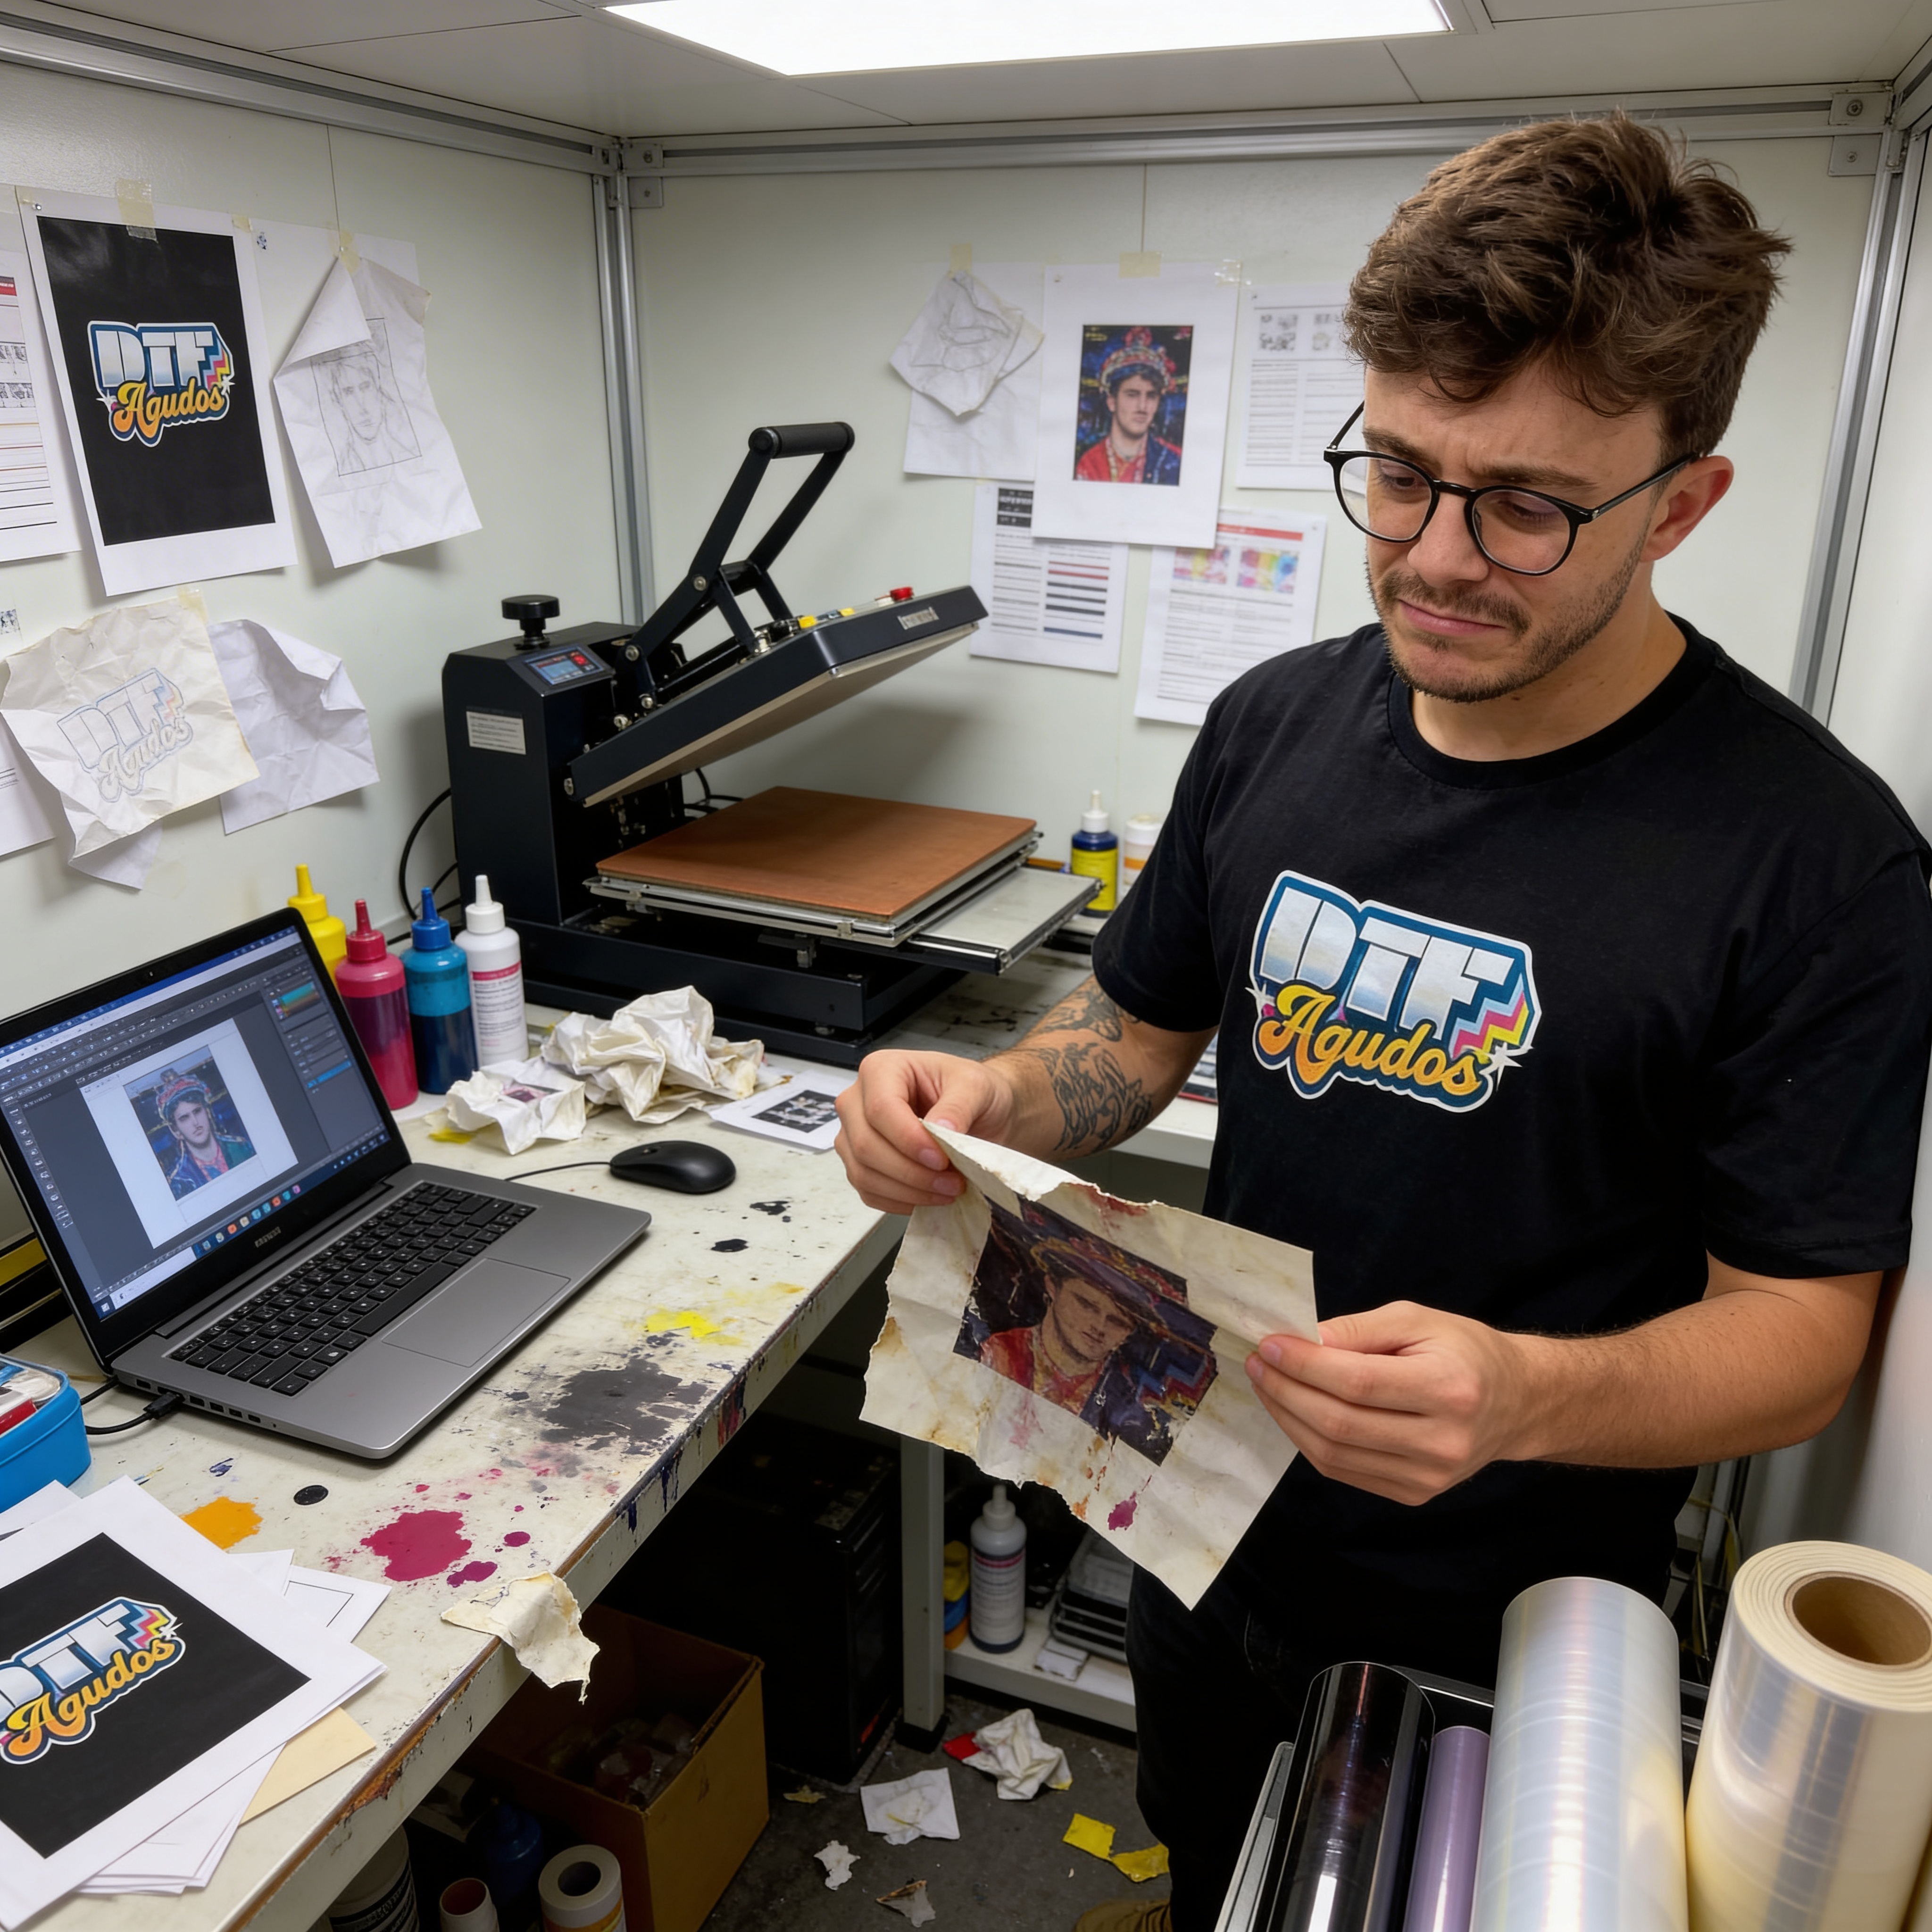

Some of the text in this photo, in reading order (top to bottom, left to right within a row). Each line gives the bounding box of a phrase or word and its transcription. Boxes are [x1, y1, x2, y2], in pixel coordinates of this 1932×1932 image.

[94, 329, 213, 388] DTF
[113, 379, 225, 439] Agudos
[57, 671, 164, 770] DTF
[98, 716, 191, 803] Agudos
[1259, 886, 1515, 1041] DTF
[1258, 983, 1483, 1097] Agudos
[7, 1639, 176, 1757] Agudos
